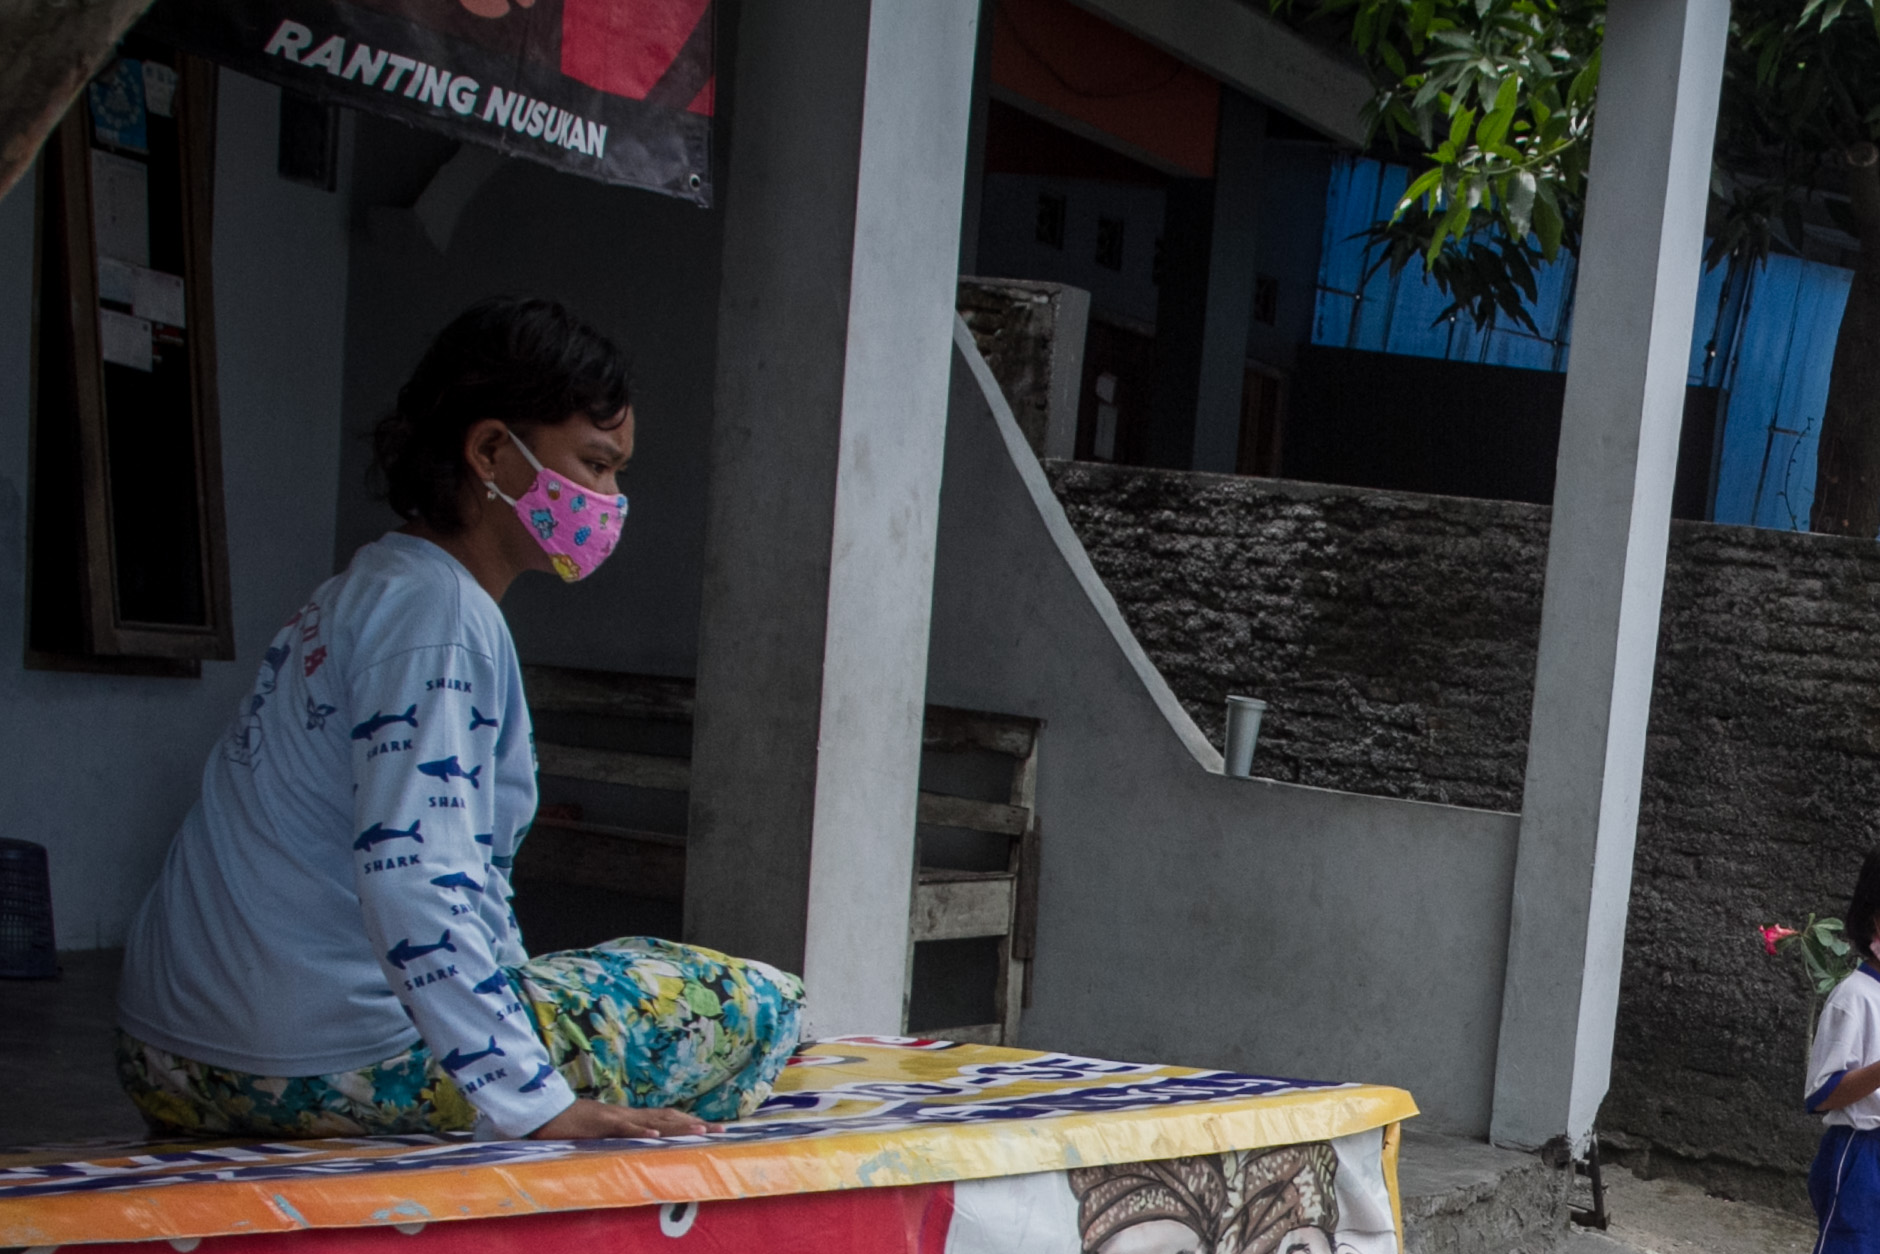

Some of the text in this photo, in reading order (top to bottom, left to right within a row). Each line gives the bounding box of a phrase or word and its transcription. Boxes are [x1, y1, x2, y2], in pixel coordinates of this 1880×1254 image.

[264, 19, 607, 159] RANTING NUSUKAN
[364, 854, 421, 875] SHARK
[404, 965, 459, 991] SHARK
